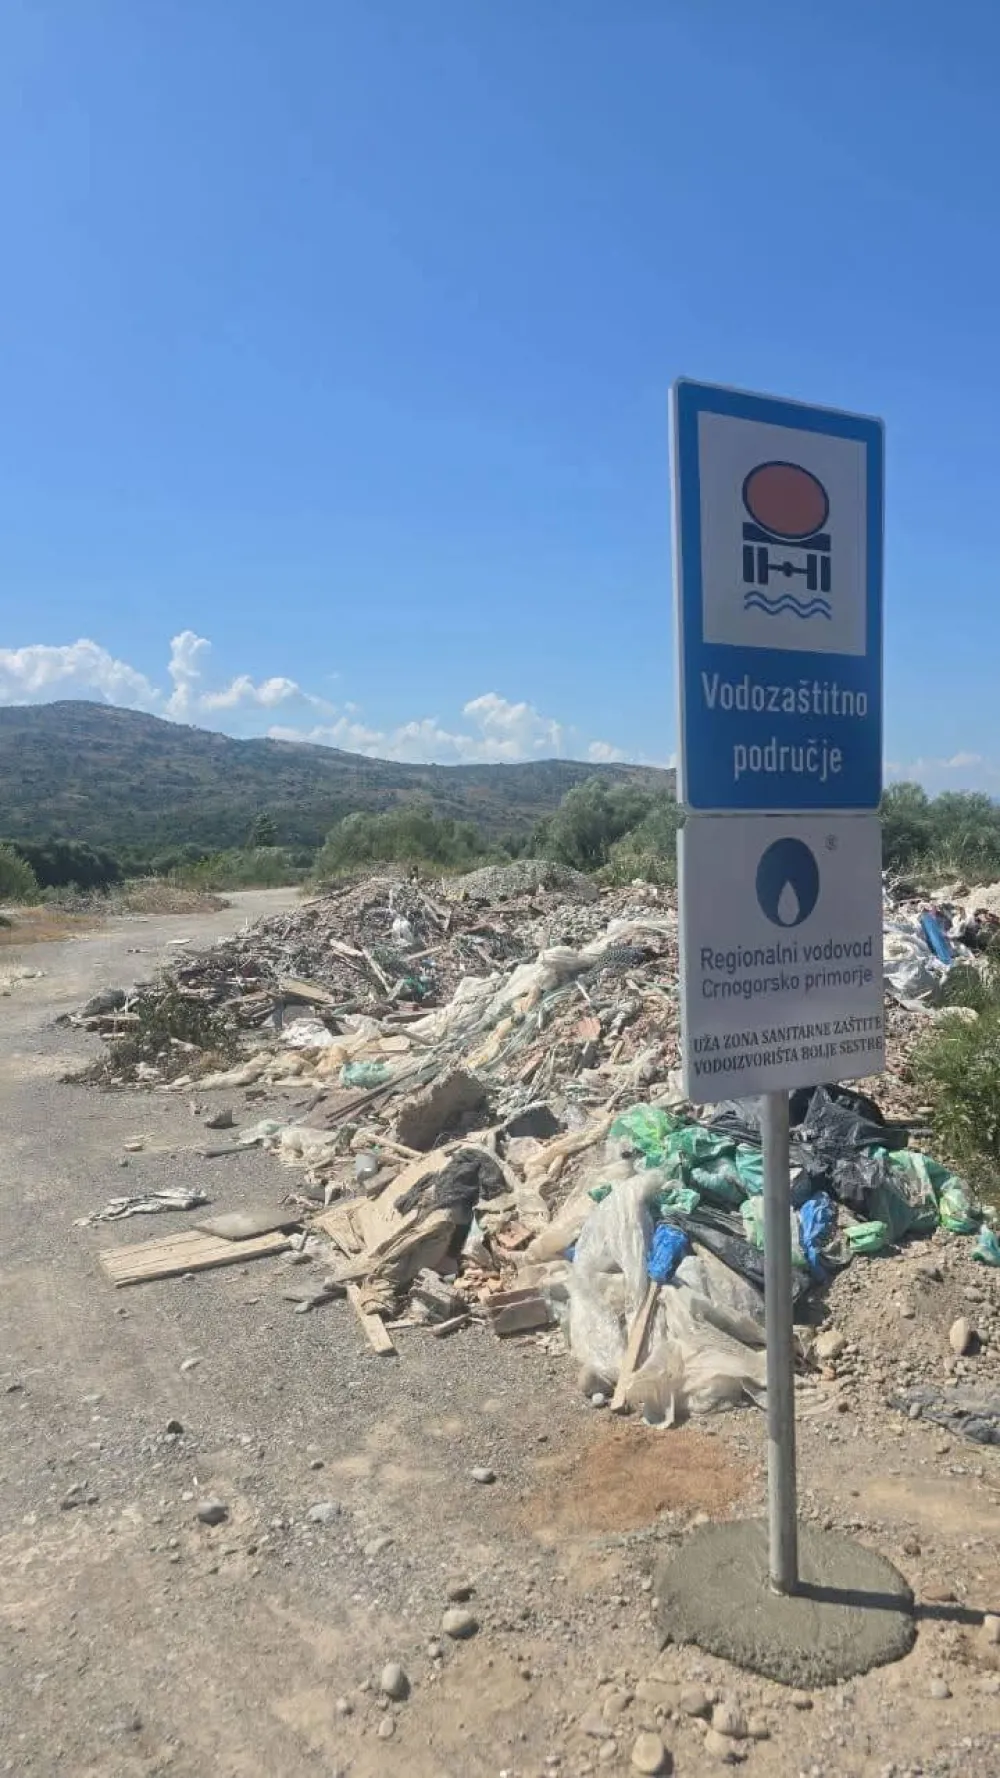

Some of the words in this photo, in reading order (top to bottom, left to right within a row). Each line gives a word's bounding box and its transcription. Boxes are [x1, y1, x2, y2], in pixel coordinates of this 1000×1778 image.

[701, 671, 868, 717] Vodozaštitno
[733, 737, 843, 781] područje
[700, 942, 798, 974] Regionalni
[803, 938, 872, 962] vodovod
[702, 972, 799, 1000] Crnogorsko
[805, 966, 873, 991] primorje
[693, 1034, 720, 1054] UŽA
[723, 1030, 759, 1049] ZONA
[762, 1021, 831, 1045] SANITARNE
[834, 1015, 883, 1036] ZAŠTITE
[694, 1048, 798, 1077] VODOIZVORIŠTA
[801, 1042, 837, 1060] BOLJE
[839, 1035, 883, 1054] SESTRE
